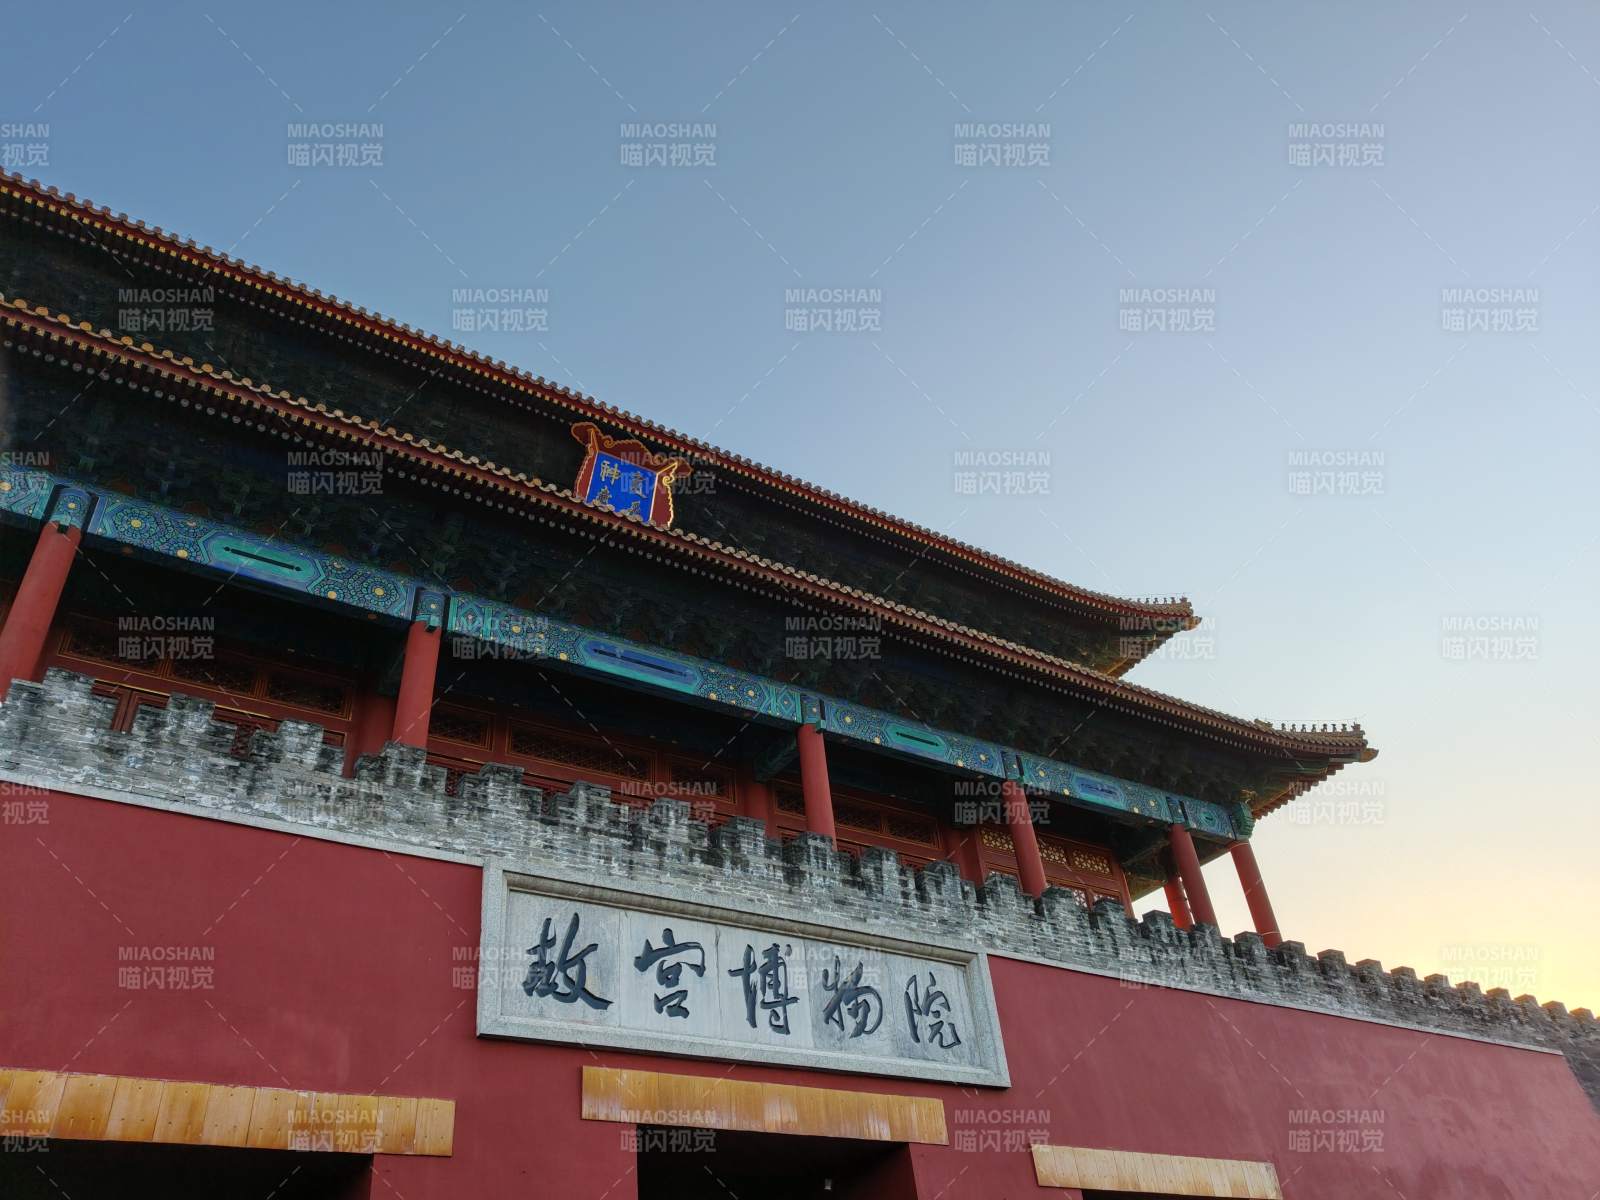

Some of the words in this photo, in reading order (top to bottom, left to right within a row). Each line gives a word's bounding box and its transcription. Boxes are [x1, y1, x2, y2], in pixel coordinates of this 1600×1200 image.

[520, 911, 962, 1050] 故宫博物院
